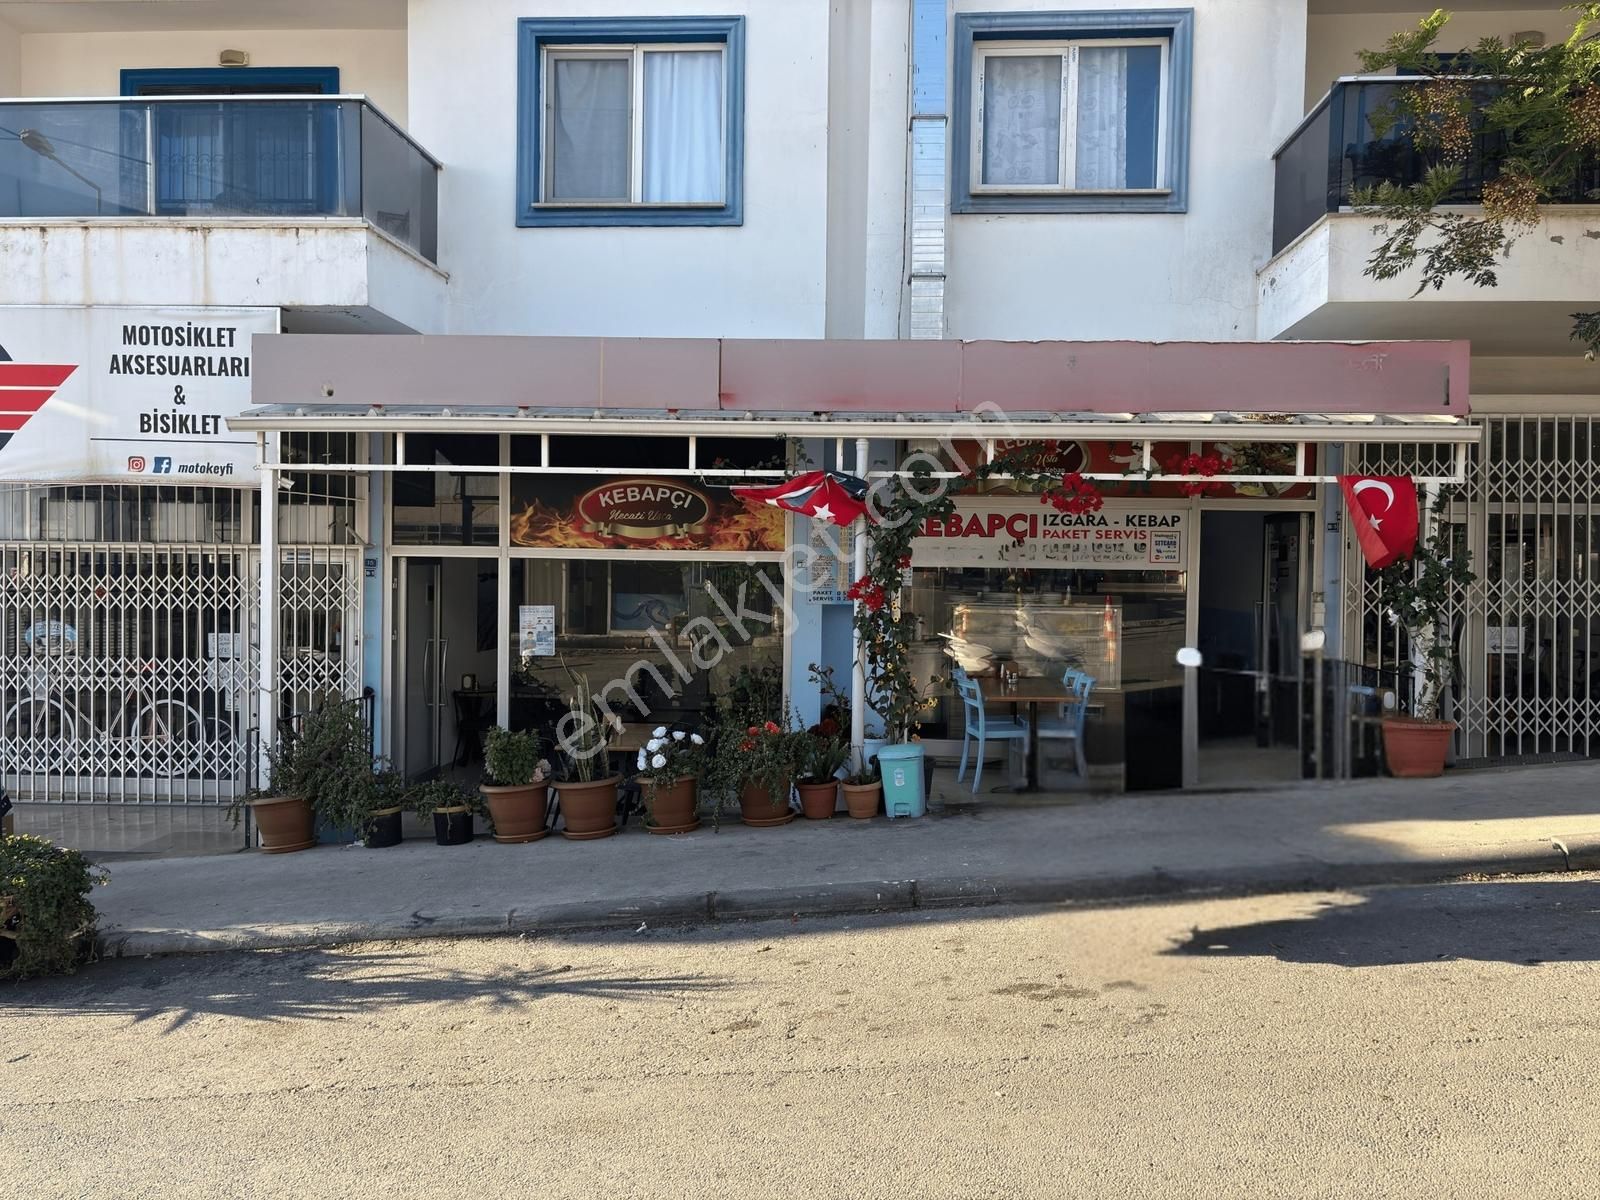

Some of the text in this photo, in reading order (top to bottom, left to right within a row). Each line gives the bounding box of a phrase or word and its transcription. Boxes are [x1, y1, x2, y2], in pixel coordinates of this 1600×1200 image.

[122, 321, 237, 347] MOTOSİKLET
[109, 354, 250, 377] AKSESUARLARI
[174, 384, 186, 405] &
[139, 408, 222, 435] BİSİKLET
[178, 462, 234, 477] motokeyfi
[599, 486, 693, 509] KEBAPÇI
[609, 509, 646, 520] Necati
[1043, 513, 1108, 527] IZGARA
[1125, 514, 1181, 527] KEBAP
[1042, 529, 1091, 539] PAKET
[1095, 527, 1147, 540] SERVİS
